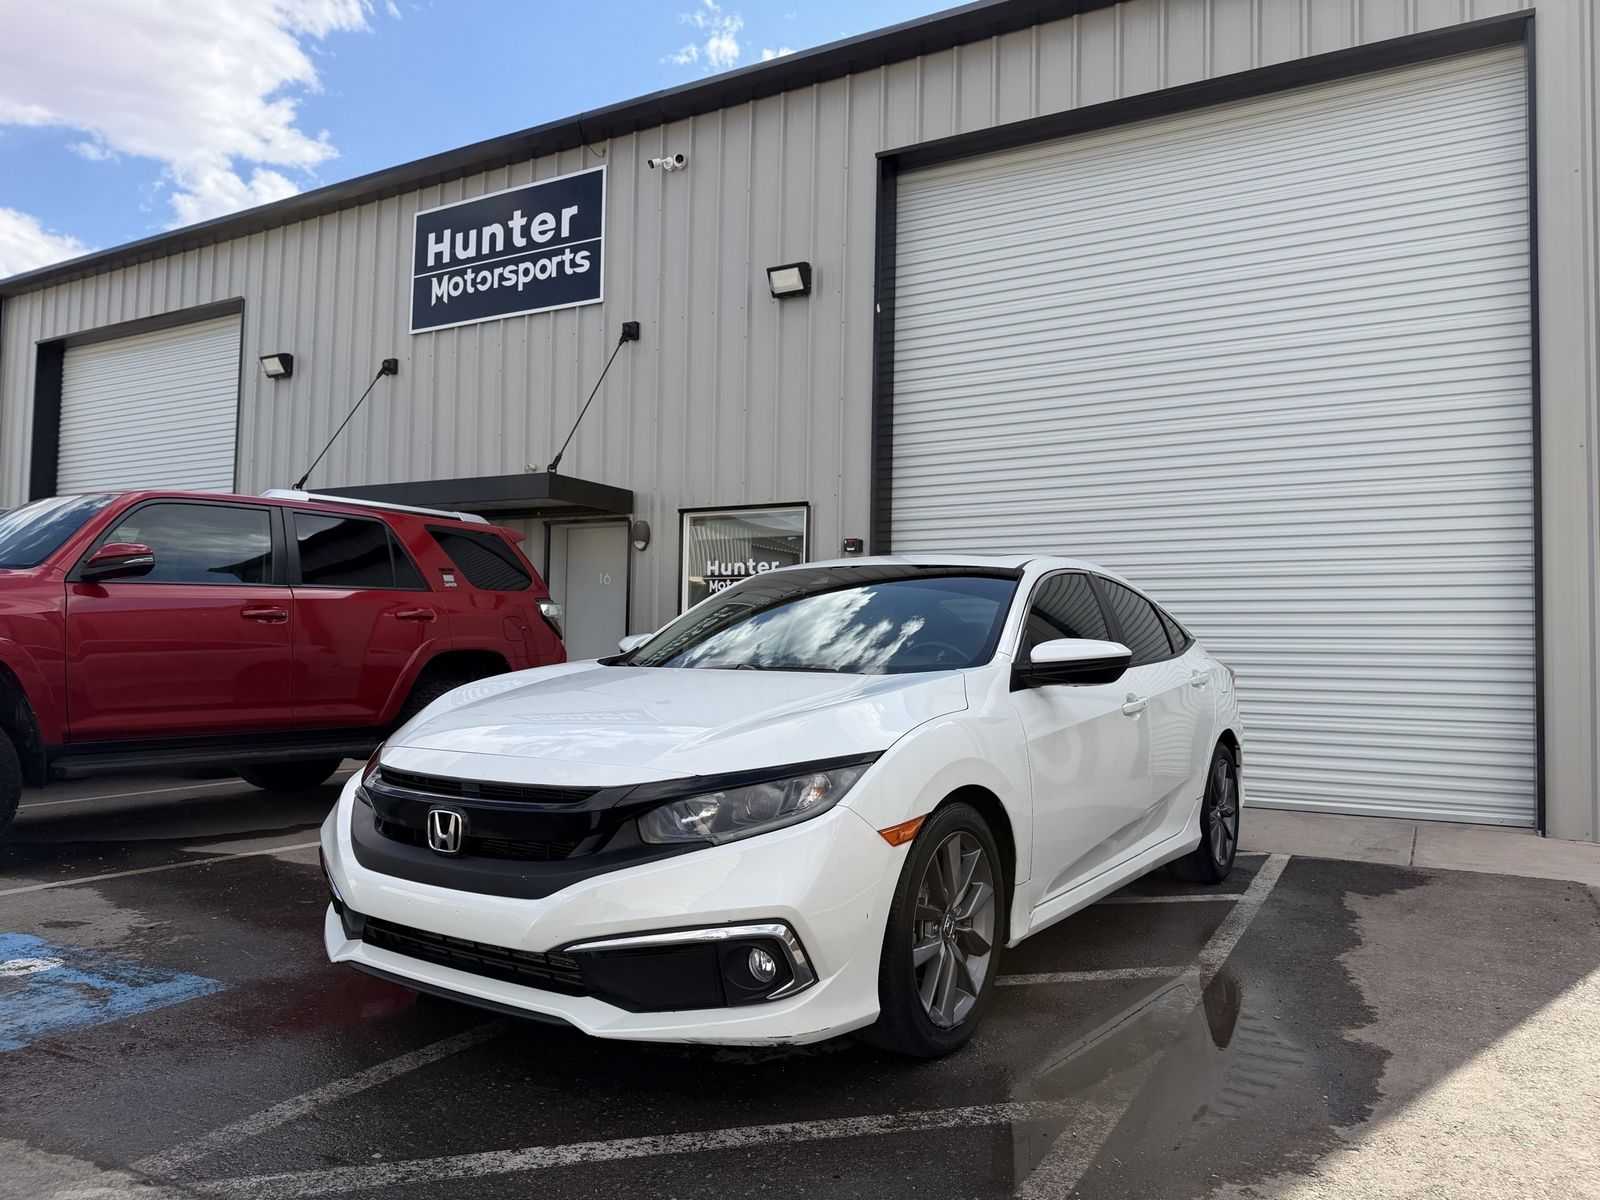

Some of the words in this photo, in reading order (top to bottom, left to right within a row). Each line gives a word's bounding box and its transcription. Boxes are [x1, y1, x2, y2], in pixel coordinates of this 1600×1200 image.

[427, 204, 578, 267] Hunter
[430, 248, 591, 307] Motorsports
[597, 571, 611, 585] 16
[706, 558, 780, 576] Hunter
